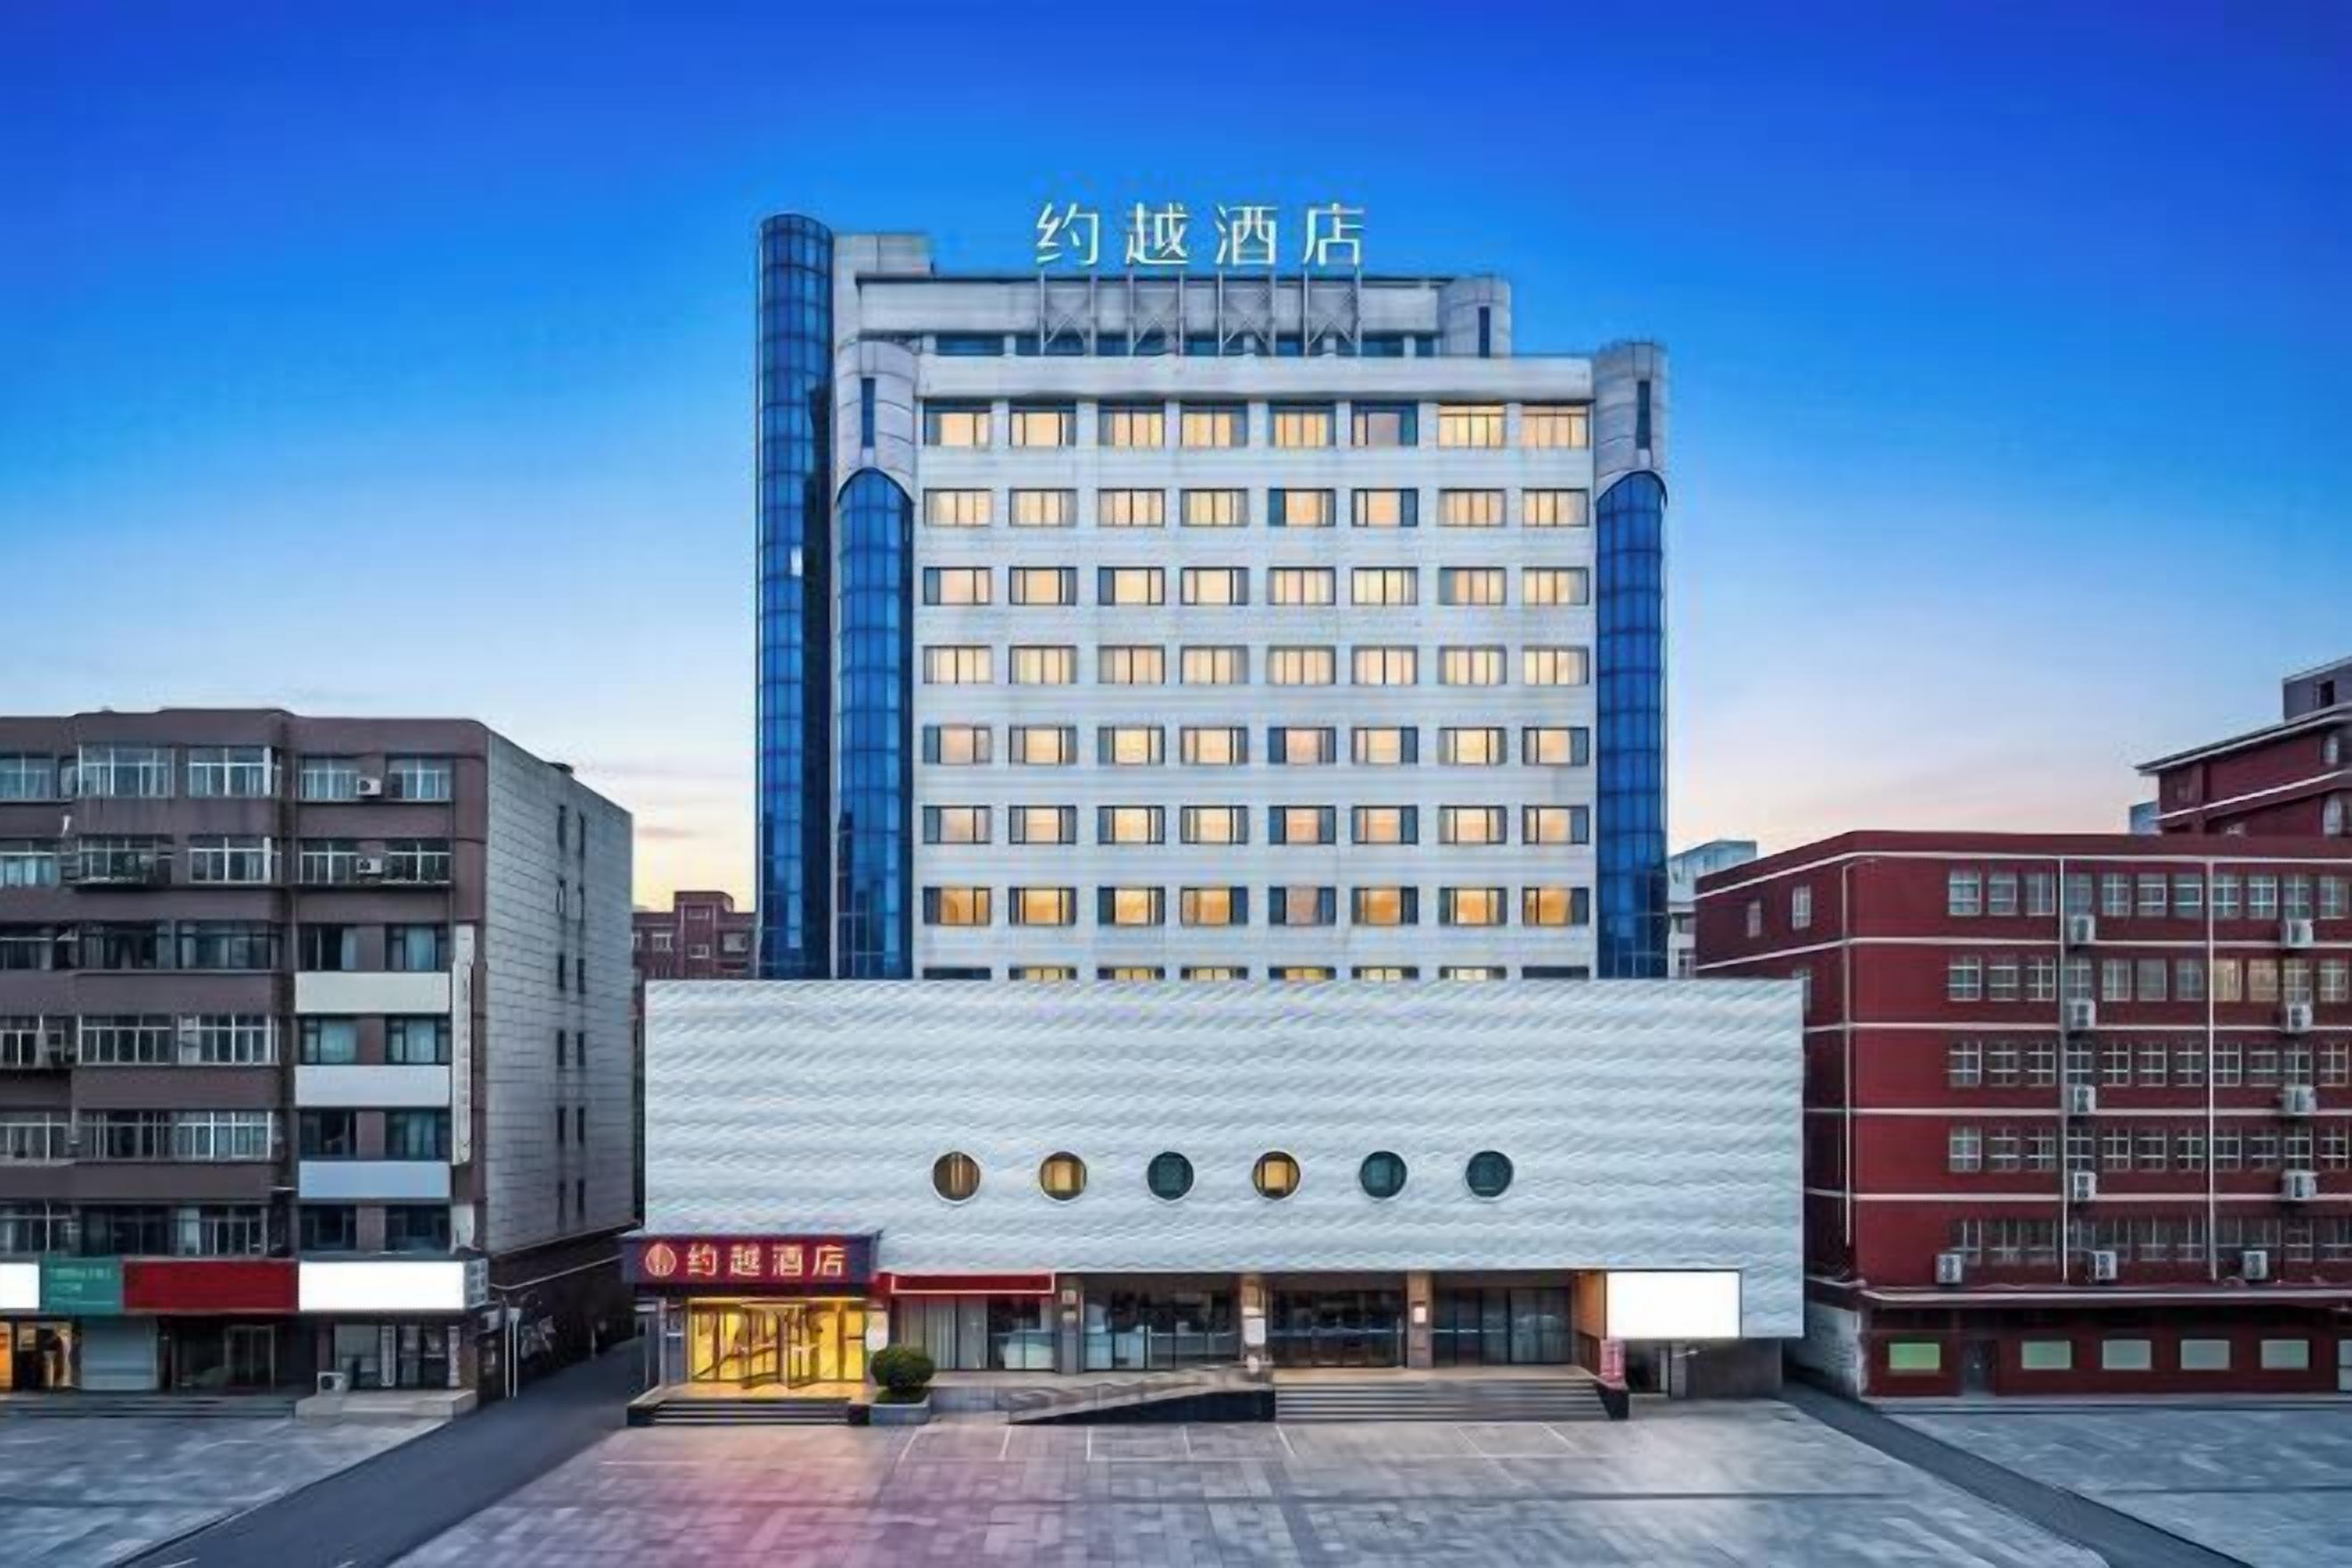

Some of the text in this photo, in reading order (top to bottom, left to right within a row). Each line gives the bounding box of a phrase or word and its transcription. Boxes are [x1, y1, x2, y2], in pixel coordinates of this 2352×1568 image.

[1035, 202, 1367, 266] 约越酒店
[687, 1243, 845, 1277] 约越酒店
